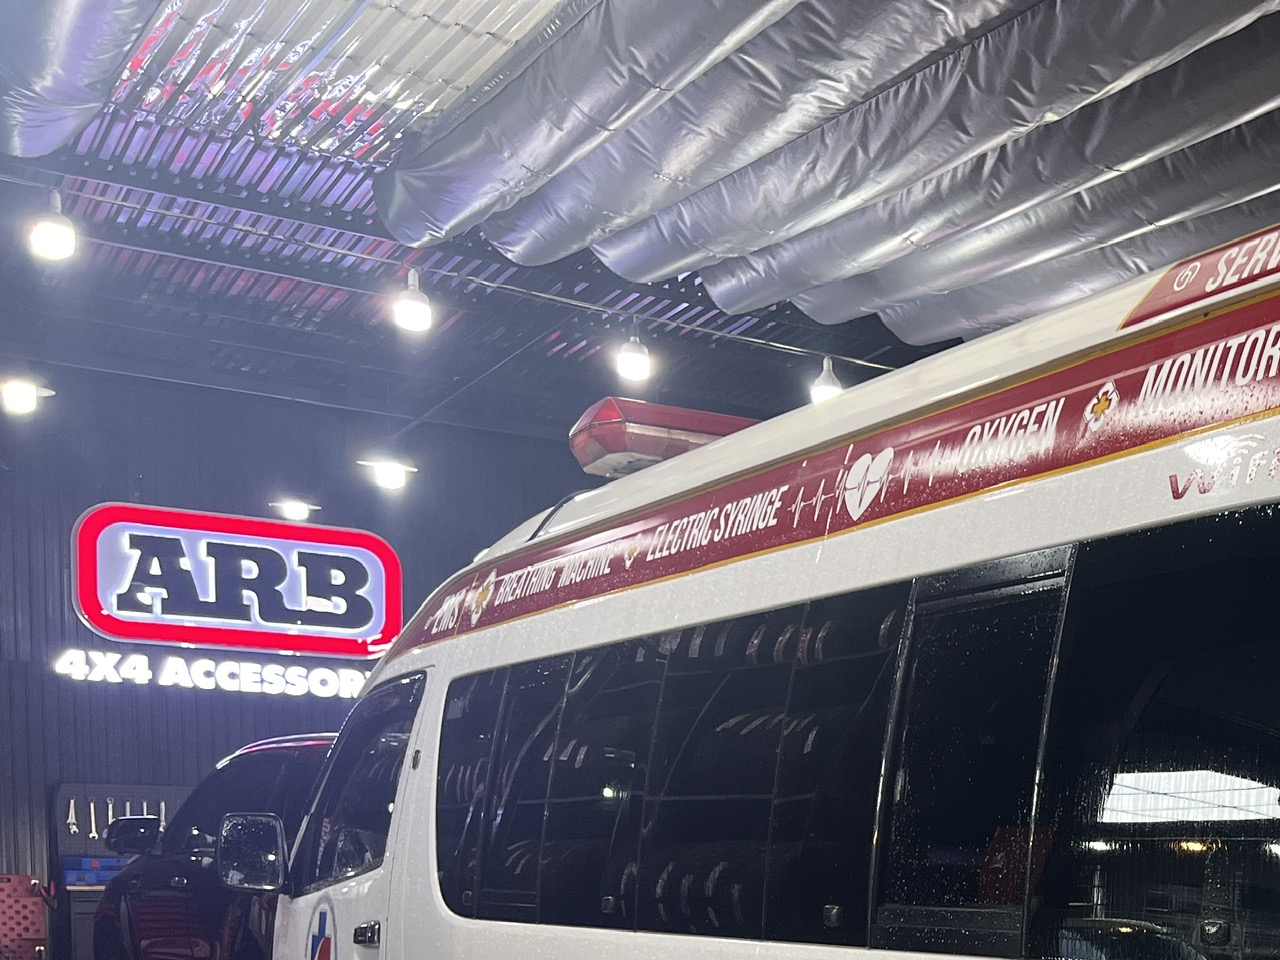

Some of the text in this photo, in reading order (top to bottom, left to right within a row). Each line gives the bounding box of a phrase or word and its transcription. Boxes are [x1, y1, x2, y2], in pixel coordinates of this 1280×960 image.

[646, 507, 720, 561] ELECTRIC
[713, 485, 790, 543] SYRINGE
[958, 397, 1065, 472] OXYGEN
[115, 532, 374, 630] ARB
[158, 656, 372, 699] ACCESSOR
